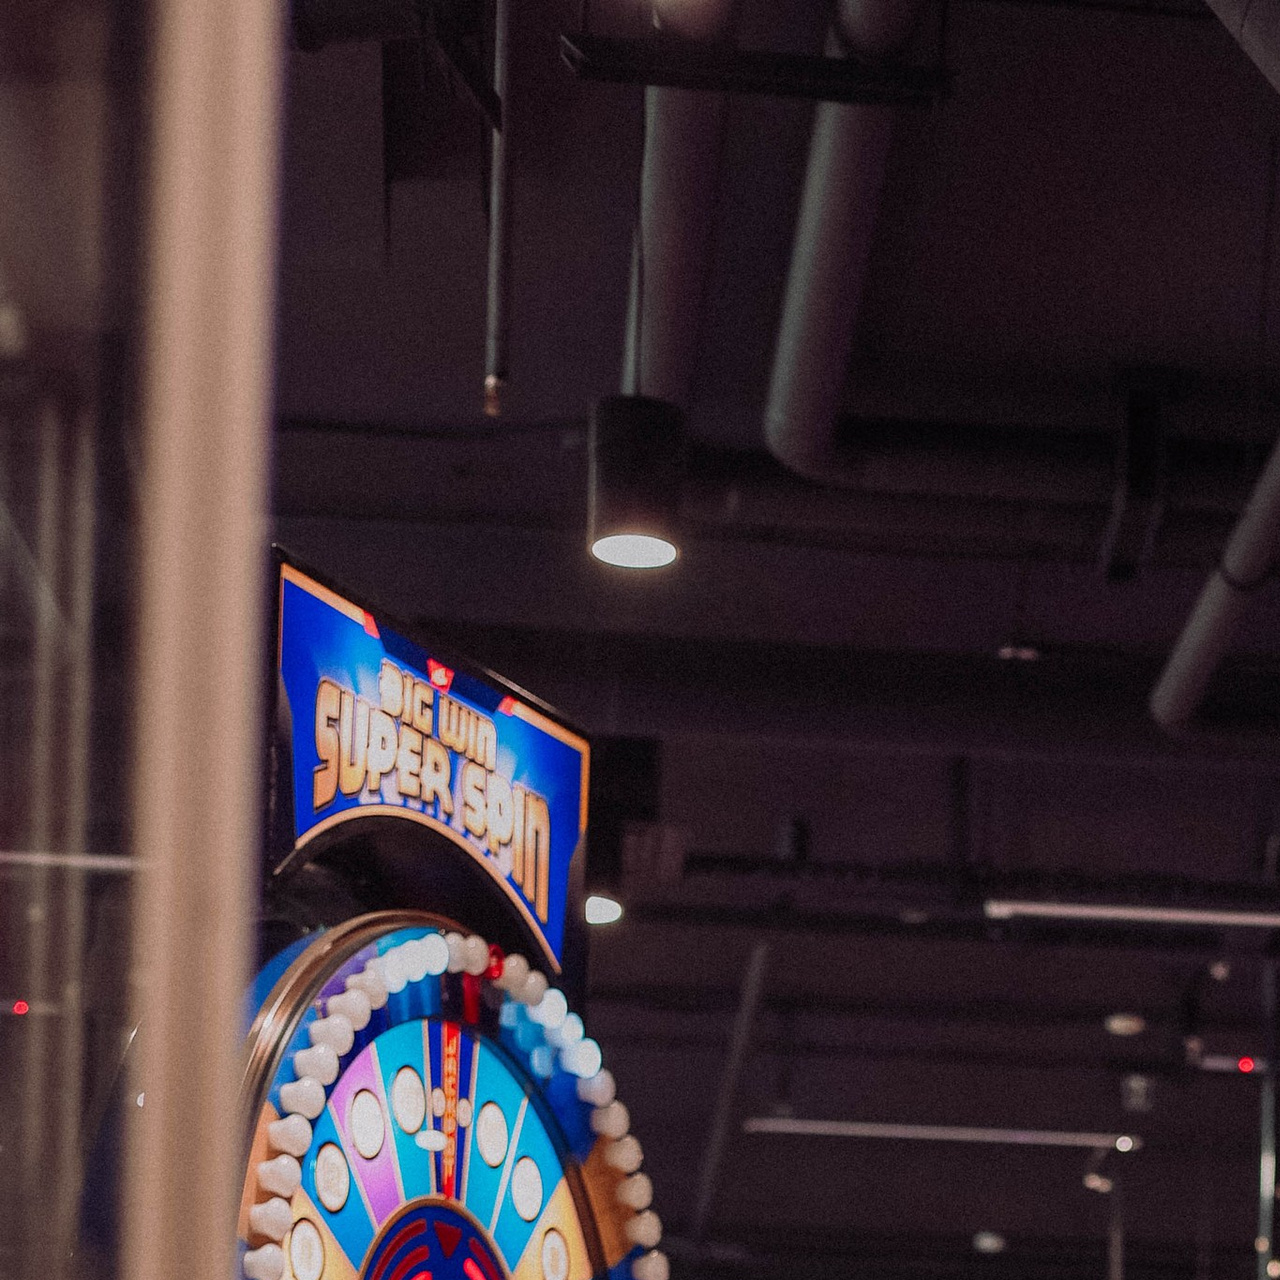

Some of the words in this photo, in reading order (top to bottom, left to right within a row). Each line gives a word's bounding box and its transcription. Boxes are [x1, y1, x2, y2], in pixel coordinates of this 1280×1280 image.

[313, 675, 454, 815] SUPER
[462, 760, 550, 925] SPIN
[379, 657, 434, 736] BIG
[438, 692, 497, 772] WIN
